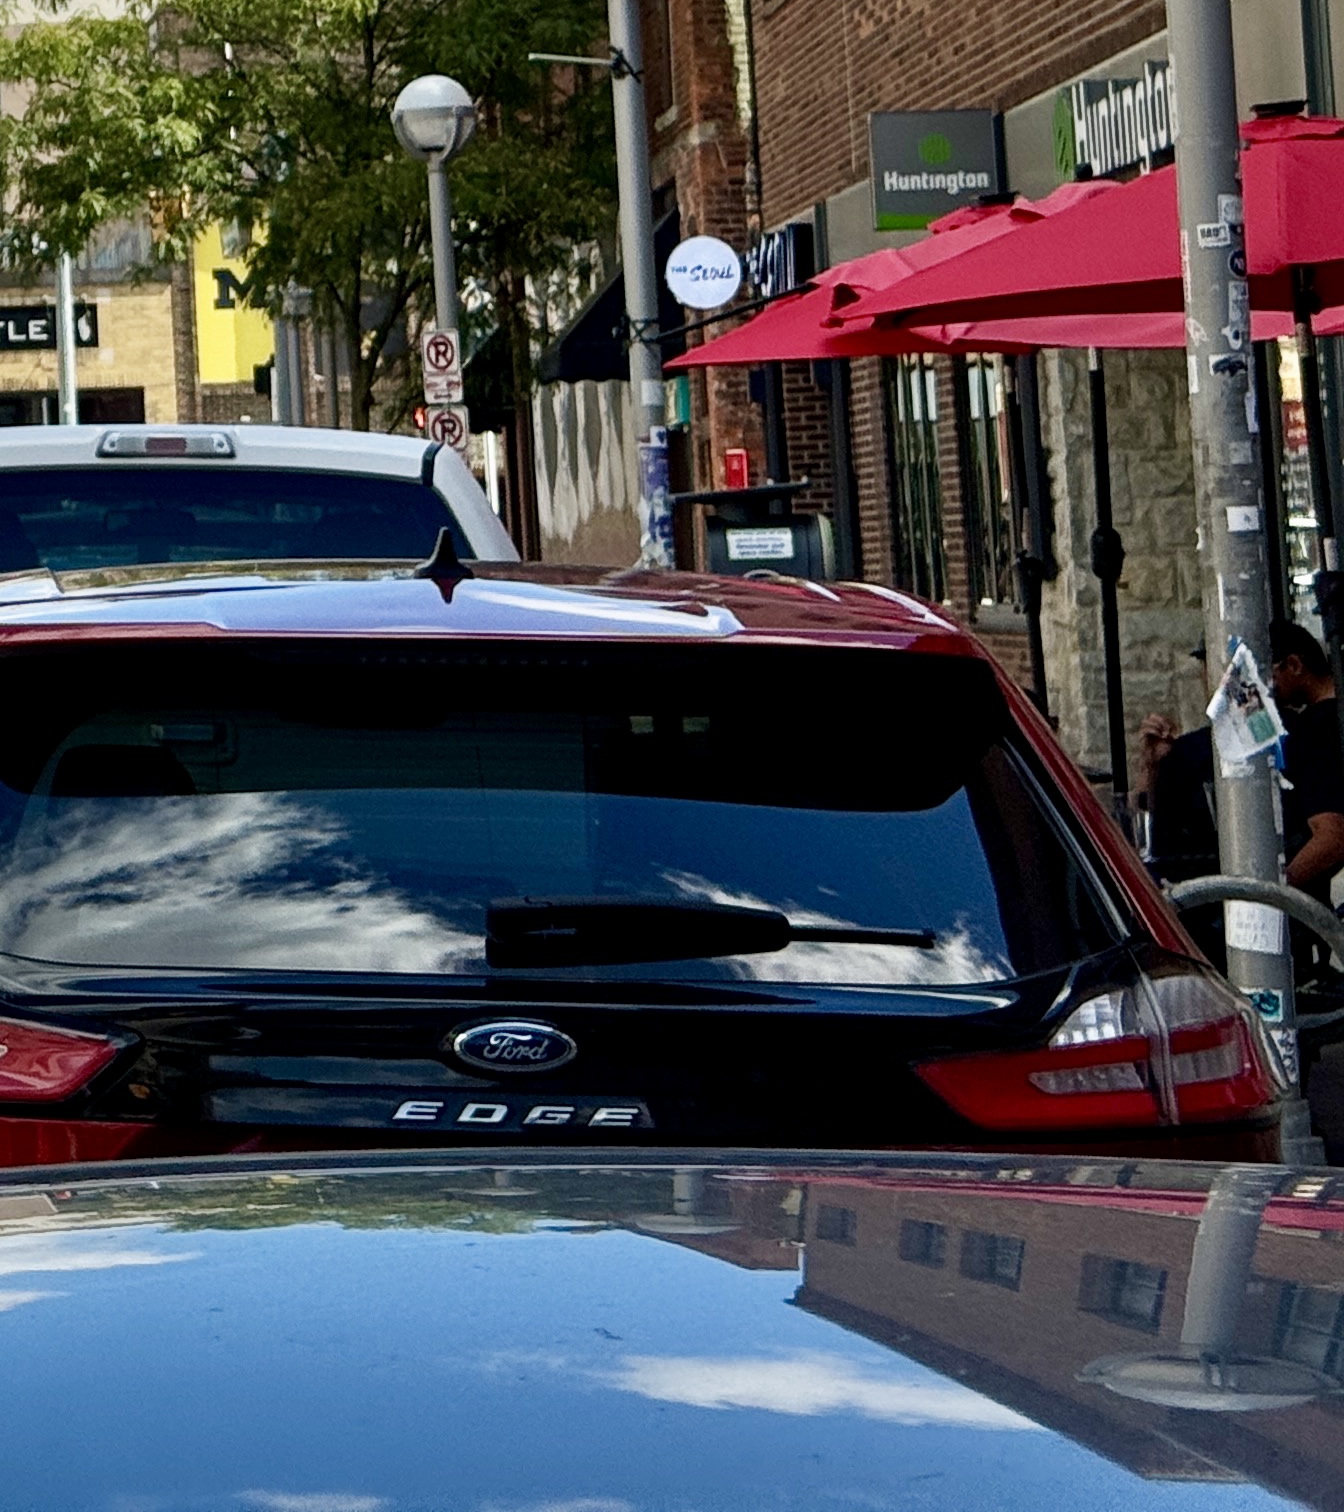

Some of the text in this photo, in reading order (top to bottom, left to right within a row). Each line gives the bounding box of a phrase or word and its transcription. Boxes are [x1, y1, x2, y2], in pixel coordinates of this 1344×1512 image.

[883, 170, 990, 196] Huntington
[482, 1032, 549, 1060] Ford
[392, 1100, 639, 1127] EDGE
